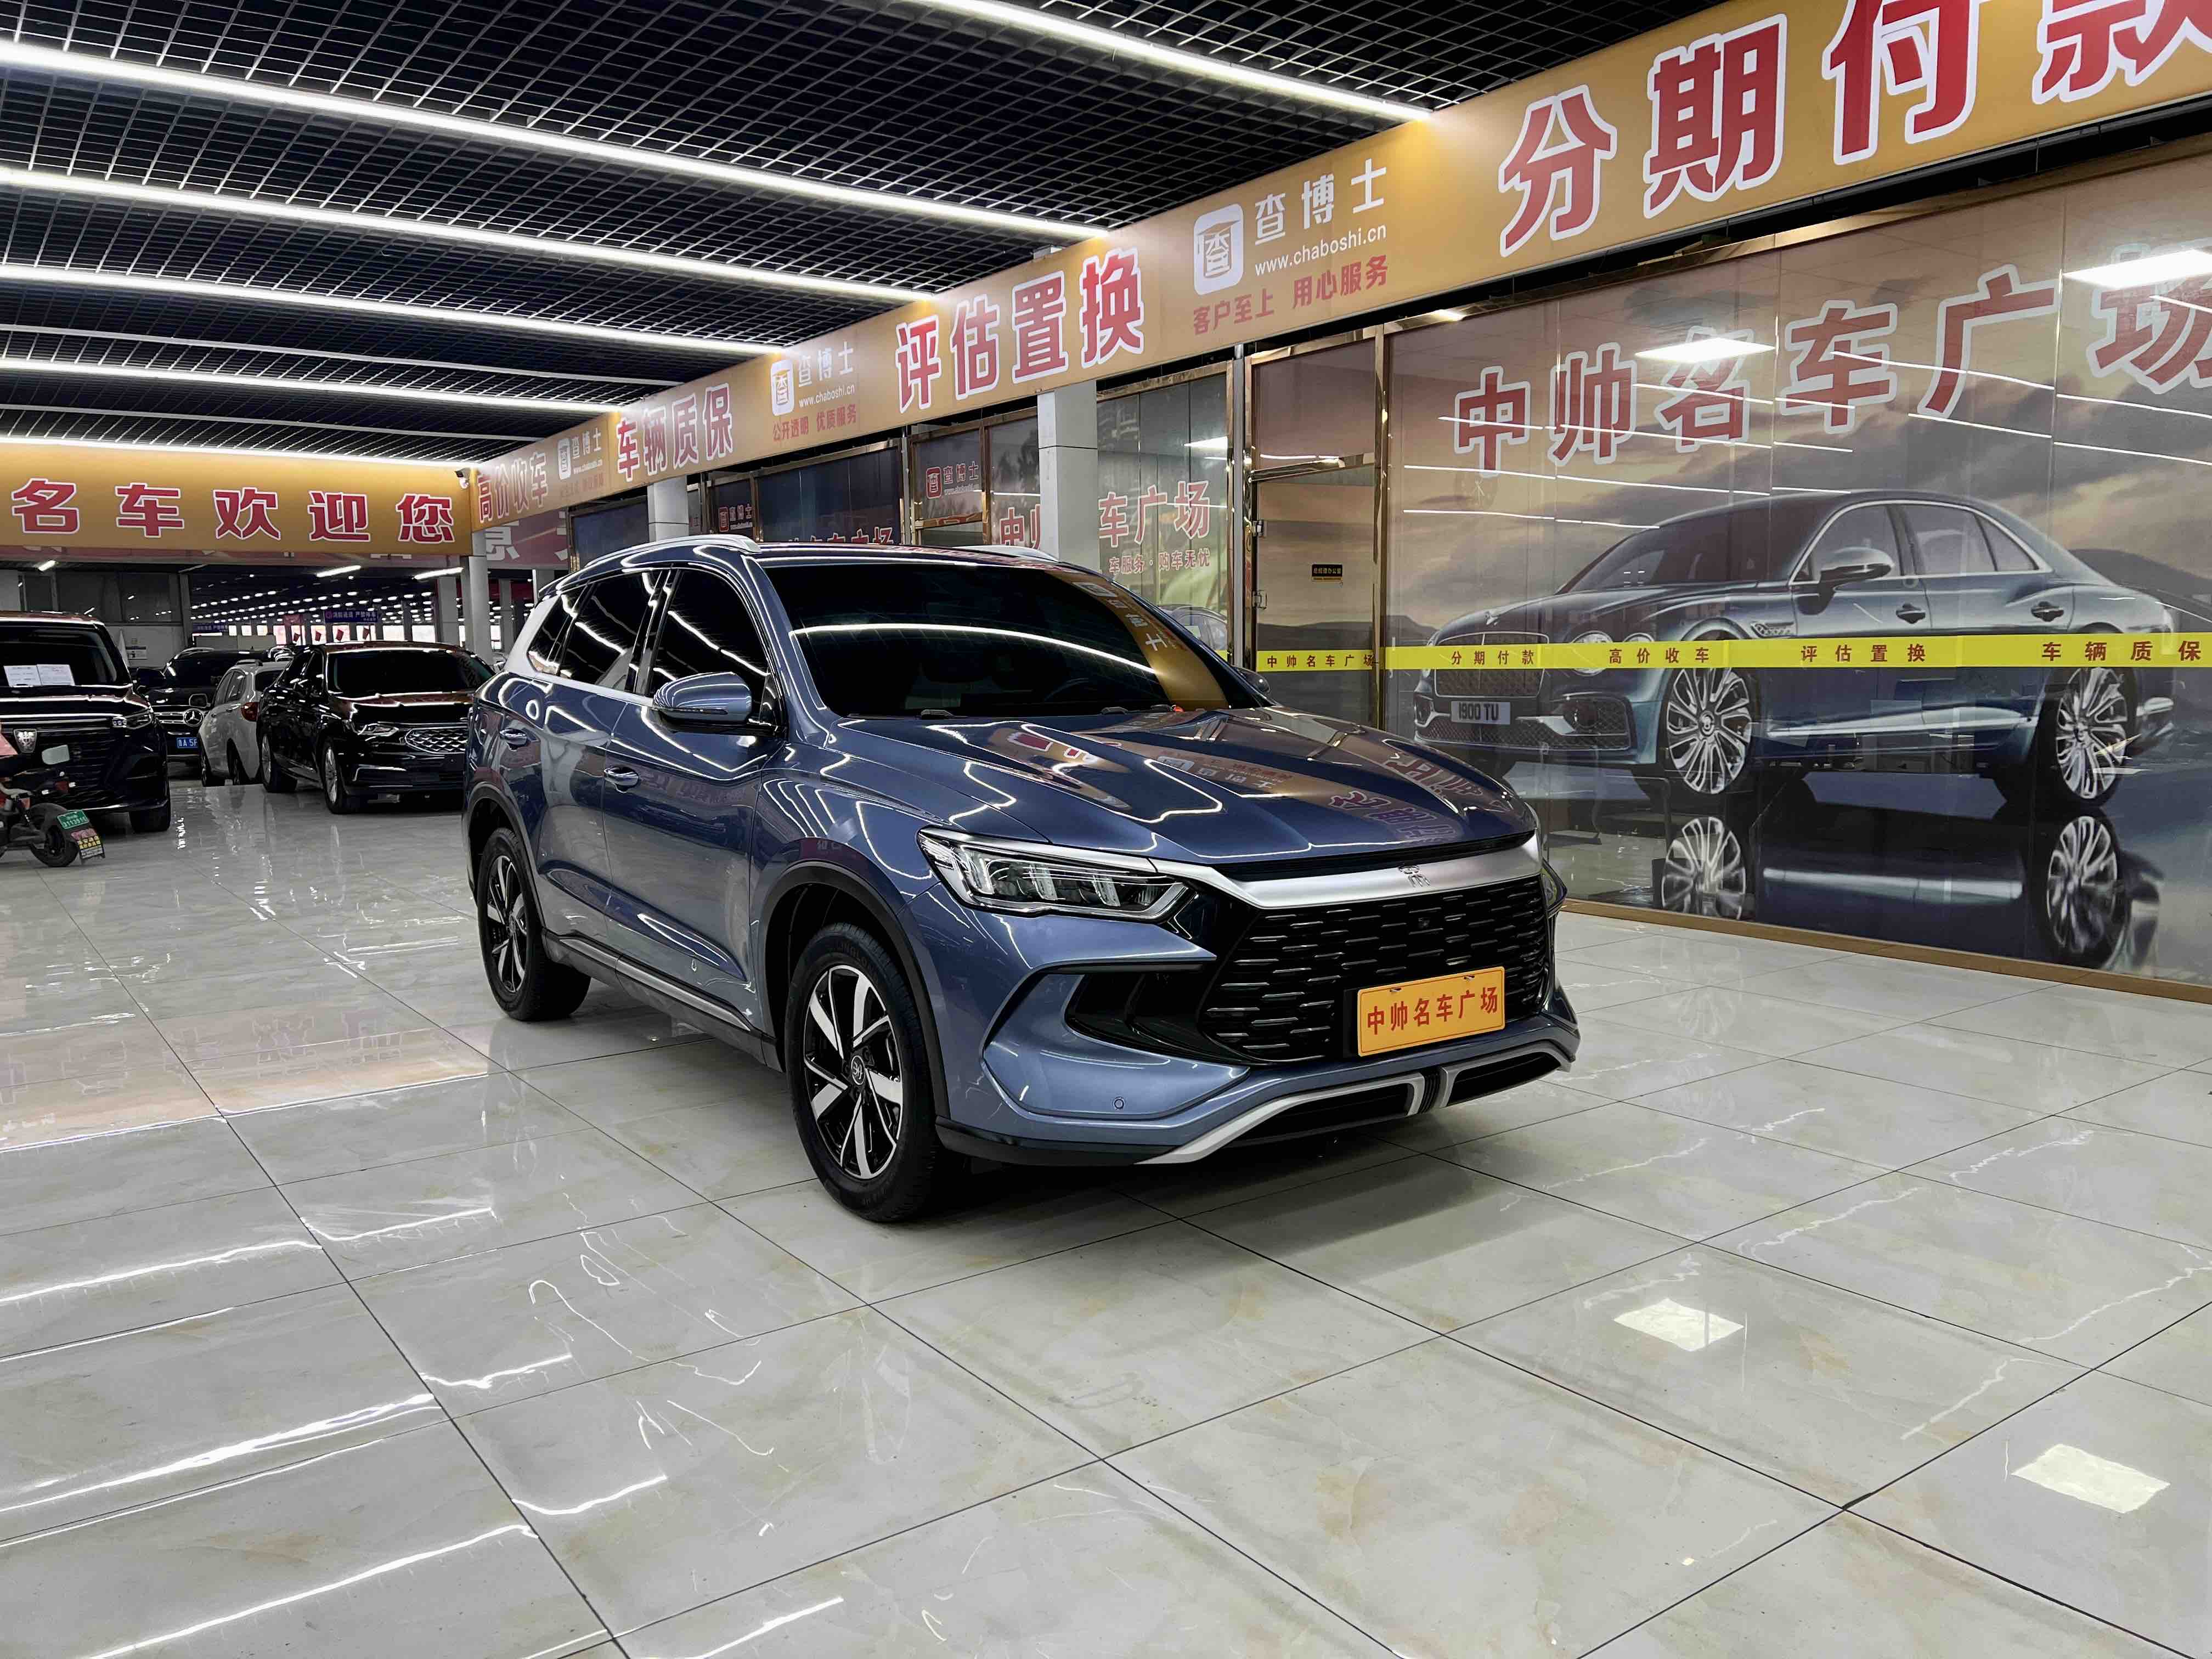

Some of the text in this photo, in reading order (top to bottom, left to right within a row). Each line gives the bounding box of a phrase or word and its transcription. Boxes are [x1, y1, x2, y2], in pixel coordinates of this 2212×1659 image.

[1255, 158, 1386, 245] 查博士
[1255, 224, 1386, 276] www.chaboshi.cn
[1194, 255, 1388, 335] 客户至上 用心服务
[896, 247, 1144, 413] 评估置换
[799, 342, 853, 387] 查博士
[1455, 238, 2212, 476] 中帅名车广场
[799, 385, 855, 408] www.chaboshi.cn
[617, 383, 732, 482] 车辆质保
[772, 404, 856, 442] 公开透明 优质服务
[11, 477, 454, 543] 名车欢迎您
[478, 452, 548, 523] 高价收车
[1267, 654, 1374, 668] 中帅名车广场
[1451, 650, 1534, 665] 分期付款
[1609, 647, 1709, 664] 高价收车
[1801, 644, 1927, 663] 评估置换
[2041, 640, 2201, 661] 车辆质保
[1367, 986, 1498, 1035] 中帅名车广场
